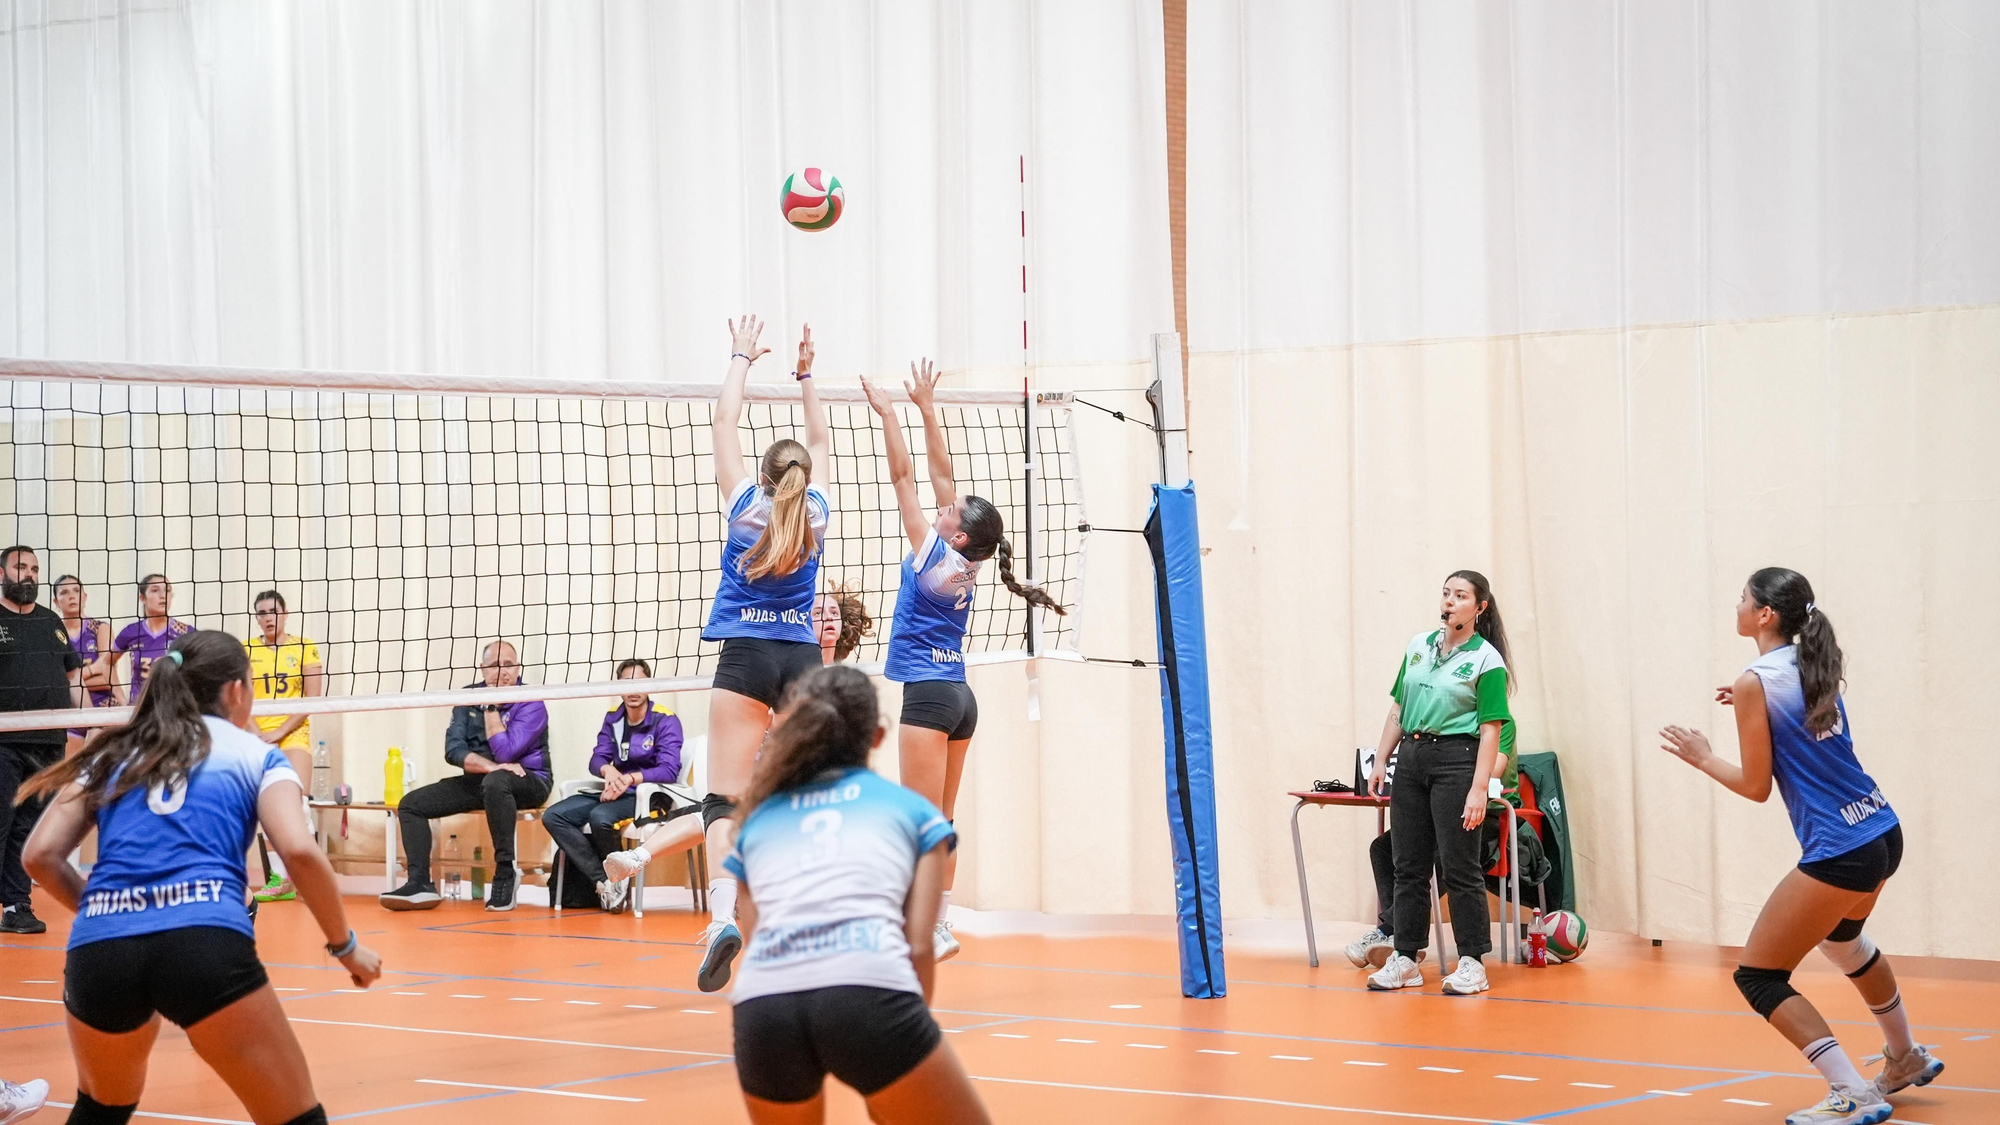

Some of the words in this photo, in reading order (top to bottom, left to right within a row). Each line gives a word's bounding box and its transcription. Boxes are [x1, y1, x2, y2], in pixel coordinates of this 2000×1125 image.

[954, 586, 967, 610] 2
[740, 608, 777, 623] MIJAS
[263, 673, 288, 694] 13
[800, 808, 844, 873] 3
[86, 886, 148, 918] MIJAS
